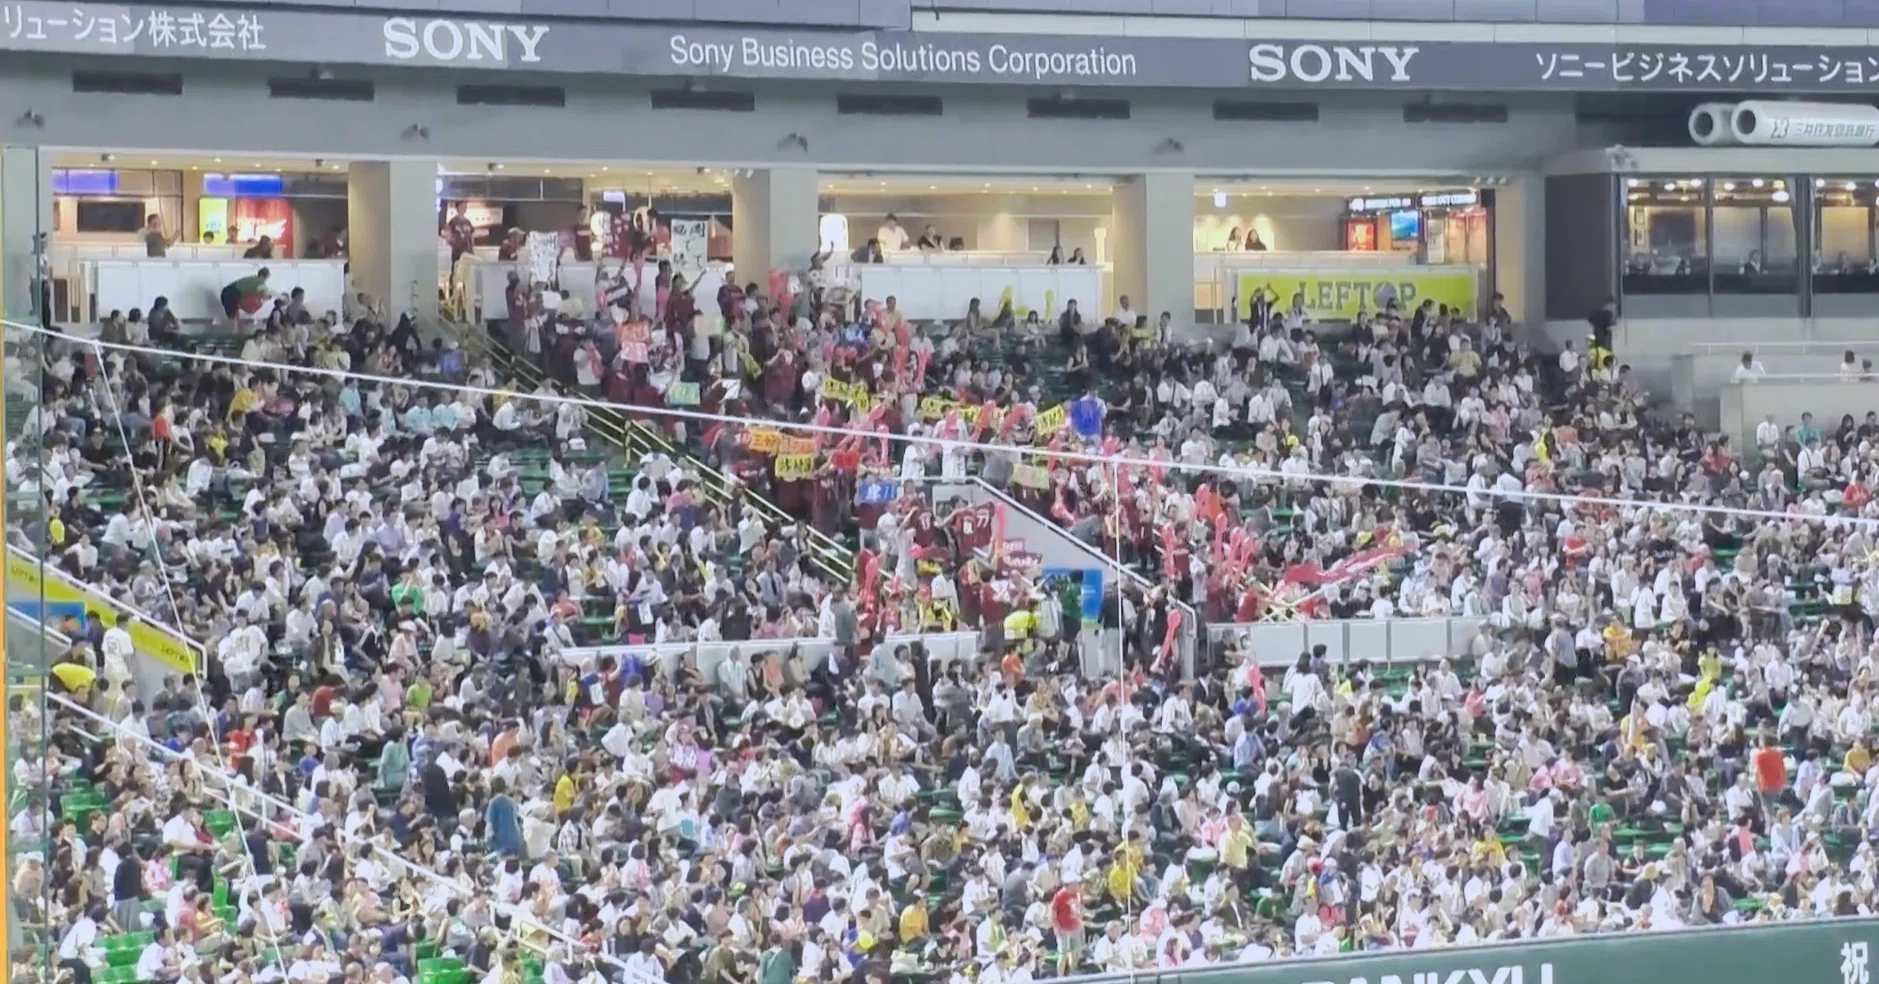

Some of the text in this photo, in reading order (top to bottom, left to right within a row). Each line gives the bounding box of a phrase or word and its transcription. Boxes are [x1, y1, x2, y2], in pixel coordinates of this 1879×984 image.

[3, 5, 267, 51] リューション株式会社
[382, 17, 550, 63] SONY
[670, 35, 1137, 80] Sony Business Solutions Corporation
[1248, 44, 1420, 83] SONY
[1840, 941, 1870, 984] 祝
